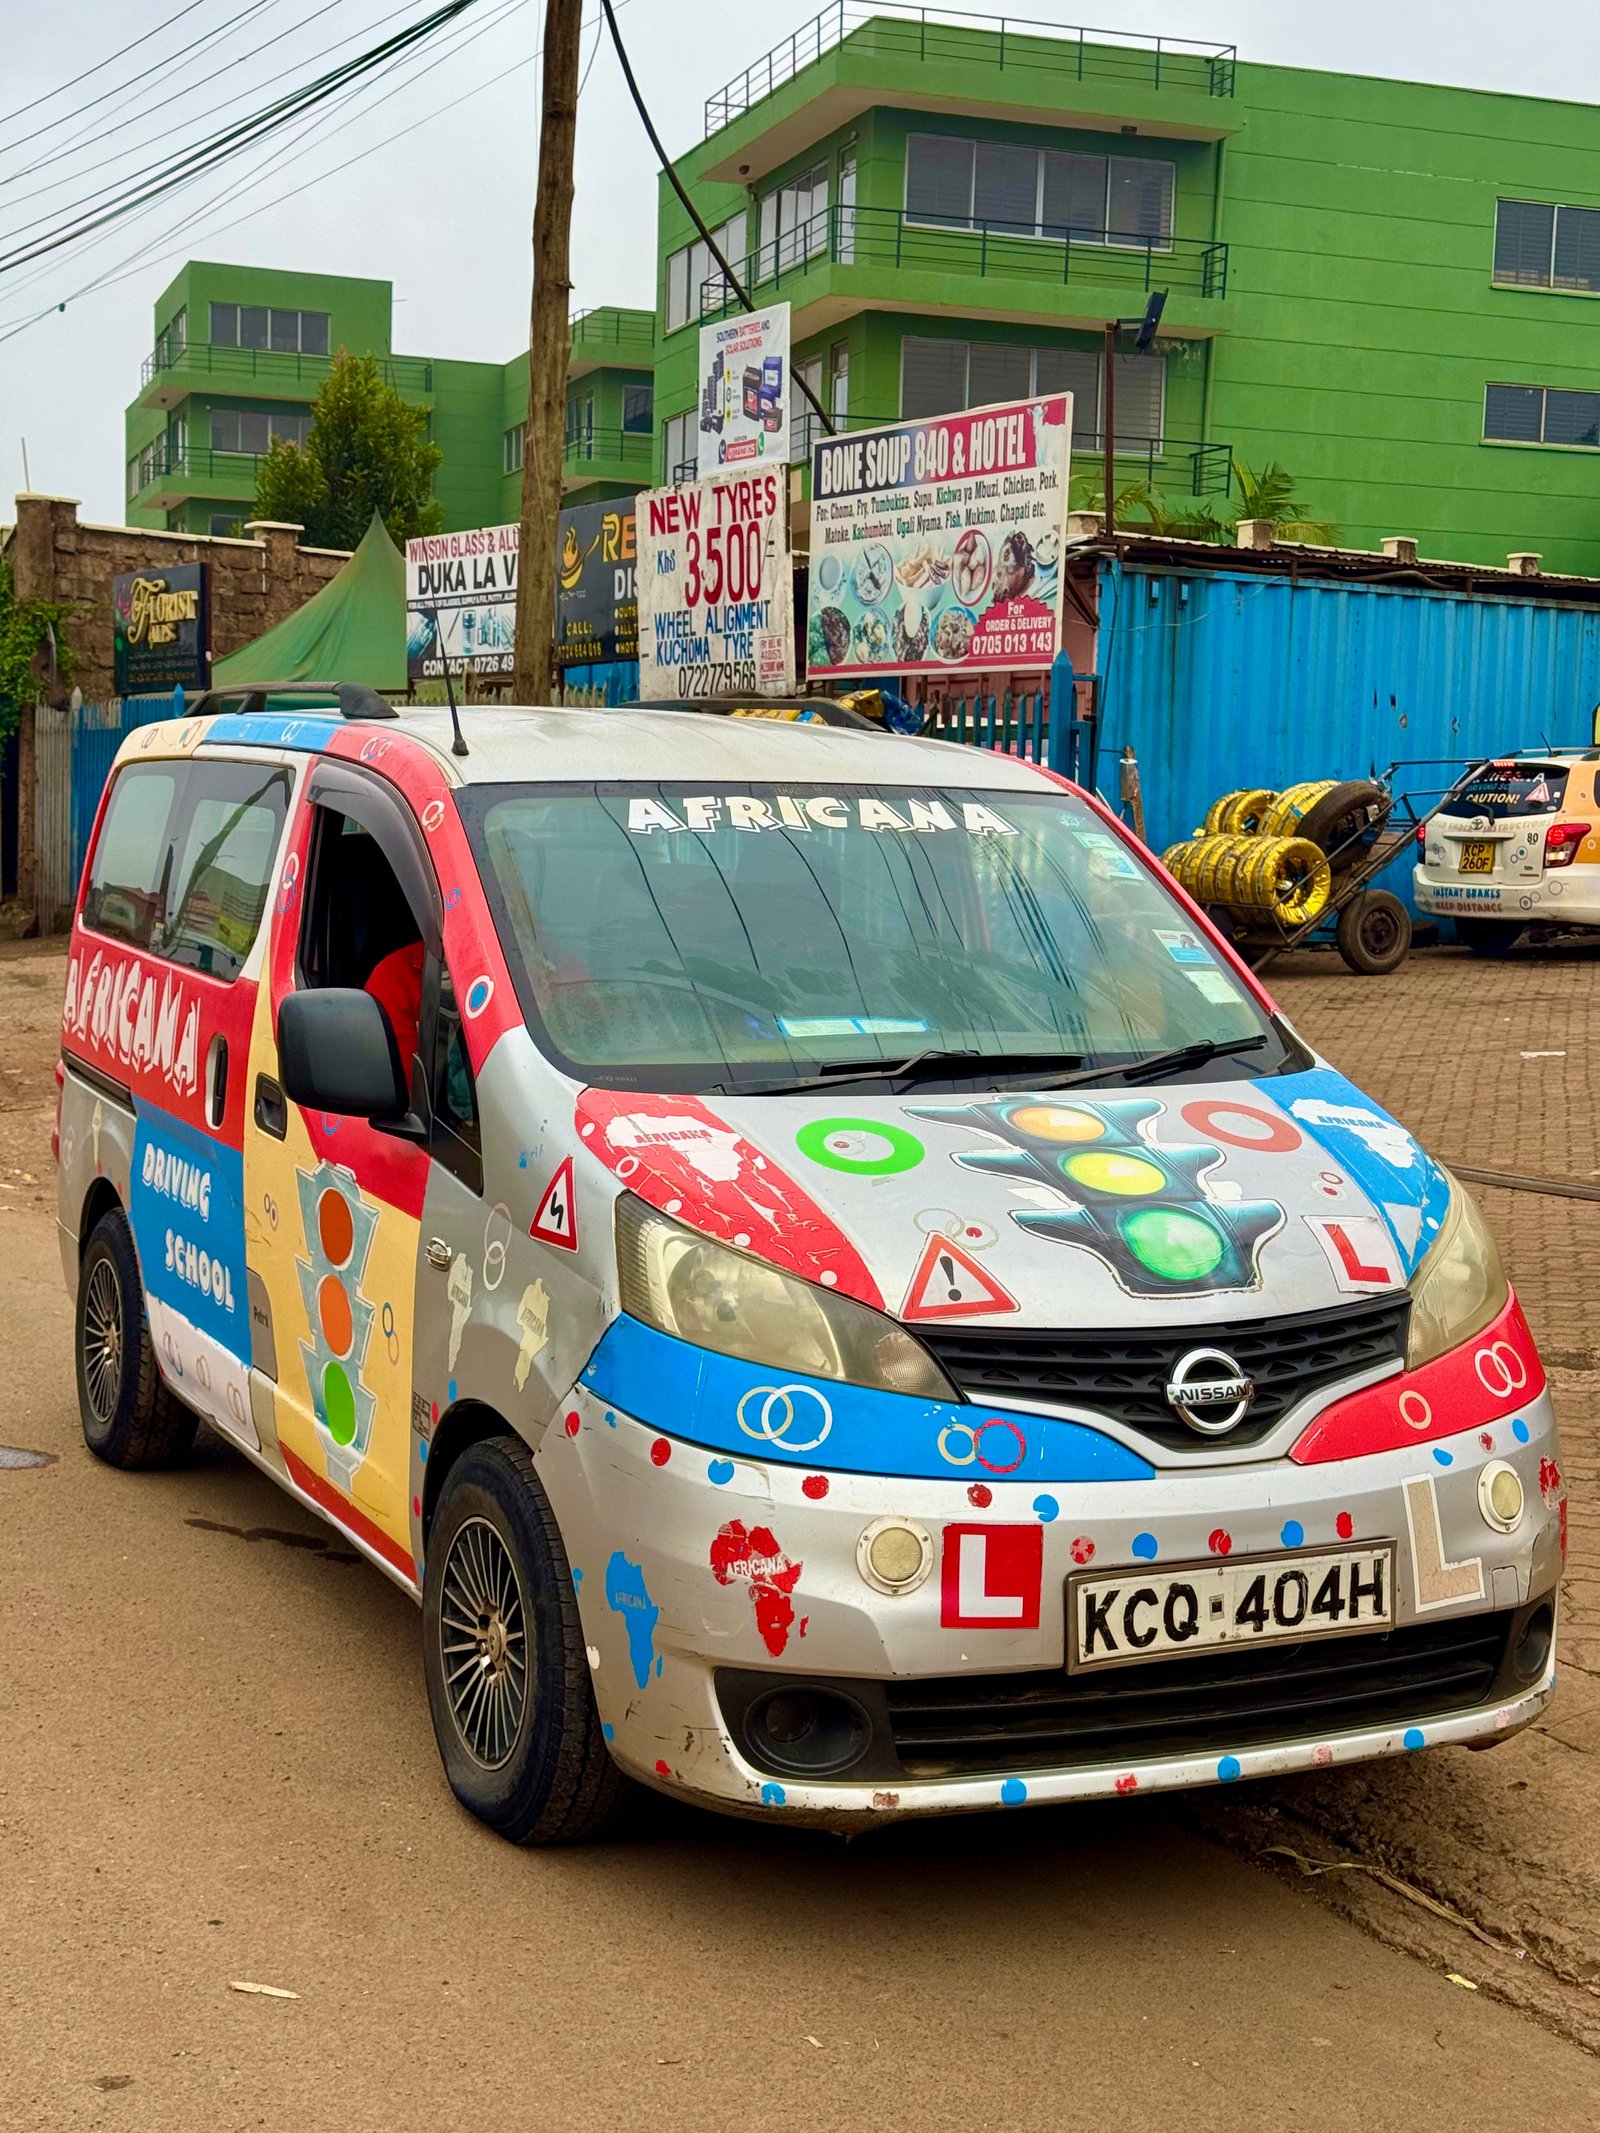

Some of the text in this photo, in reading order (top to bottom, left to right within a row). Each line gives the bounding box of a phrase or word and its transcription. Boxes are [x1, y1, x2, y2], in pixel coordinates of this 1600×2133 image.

[820, 413, 1027, 495] BONE SOUP 840 & HOTEL
[649, 475, 777, 537] NEW TYRES
[936, 486, 962, 505] Kichwa
[963, 487, 973, 503] ya
[1003, 475, 1037, 496] Chicken,
[896, 516, 915, 538] Ugali
[1000, 502, 1030, 522] Chapati
[1032, 500, 1047, 519] etc.
[409, 538, 449, 564] WINSON
[451, 532, 485, 559] GLASS
[488, 531, 495, 553] &
[602, 512, 637, 563] RE
[418, 557, 467, 595] DUKA
[473, 555, 497, 588] LA
[684, 521, 762, 608] 3500
[654, 599, 771, 640] WHEEL ALIGNMENT
[985, 616, 1053, 632] ORDER & DELIVERY
[1007, 601, 1025, 616] For
[566, 620, 593, 636] CALL:
[620, 624, 632, 635] ALL
[972, 631, 1053, 655] 0705 013 143
[473, 656, 499, 674] 0726
[501, 655, 515, 672] 49
[656, 635, 711, 667] KUCHOMA
[723, 631, 754, 662] TYRE
[678, 660, 757, 699] 0722779566
[627, 795, 1020, 835] AFRICANA
[1465, 793, 1521, 804] CAUTION!
[1464, 844, 1485, 857] KCP
[1527, 832, 1539, 844] 80
[1461, 858, 1490, 871] 260F
[1433, 886, 1500, 899] INSTANT BRAKES
[1458, 902, 1503, 913] DISTANCE
[62, 947, 201, 1097] AFRICANA
[634, 1129, 713, 1145] AFRICANA
[1317, 1115, 1388, 1130] AFRICANA
[142, 1142, 212, 1223] DRIVING
[1321, 1223, 1392, 1284] L
[165, 1228, 235, 1313] SCHOOL
[1179, 1382, 1250, 1402] NISSAN
[1402, 1473, 1486, 1614] L
[727, 1554, 786, 1576] AFRICANA
[959, 1534, 1024, 1618] L
[1084, 1557, 1385, 1656] KCQ 404H
